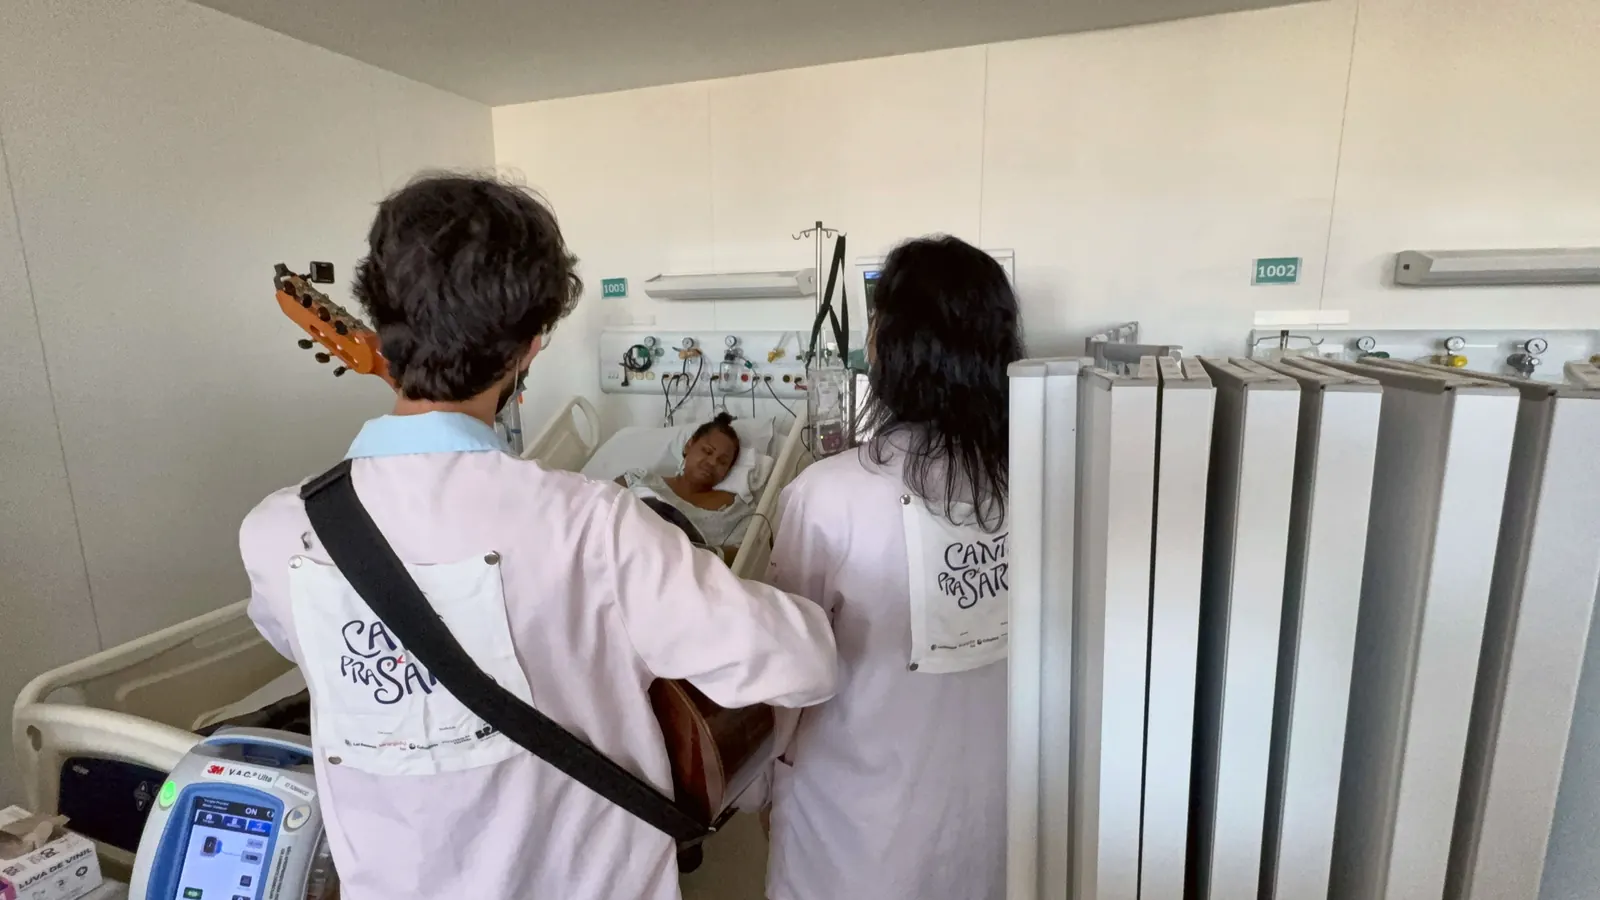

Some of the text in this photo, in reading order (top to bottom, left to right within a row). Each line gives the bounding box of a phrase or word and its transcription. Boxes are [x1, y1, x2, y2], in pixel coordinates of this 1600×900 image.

[1258, 264, 1296, 278] 1002
[604, 283, 625, 294] 1003
[944, 531, 1009, 571] CANT
[958, 562, 1009, 610] SAR
[341, 655, 383, 687] PRA
[207, 764, 225, 775] 3M
[245, 807, 258, 816] ON
[19, 848, 92, 889] LUVA DE VINIL
